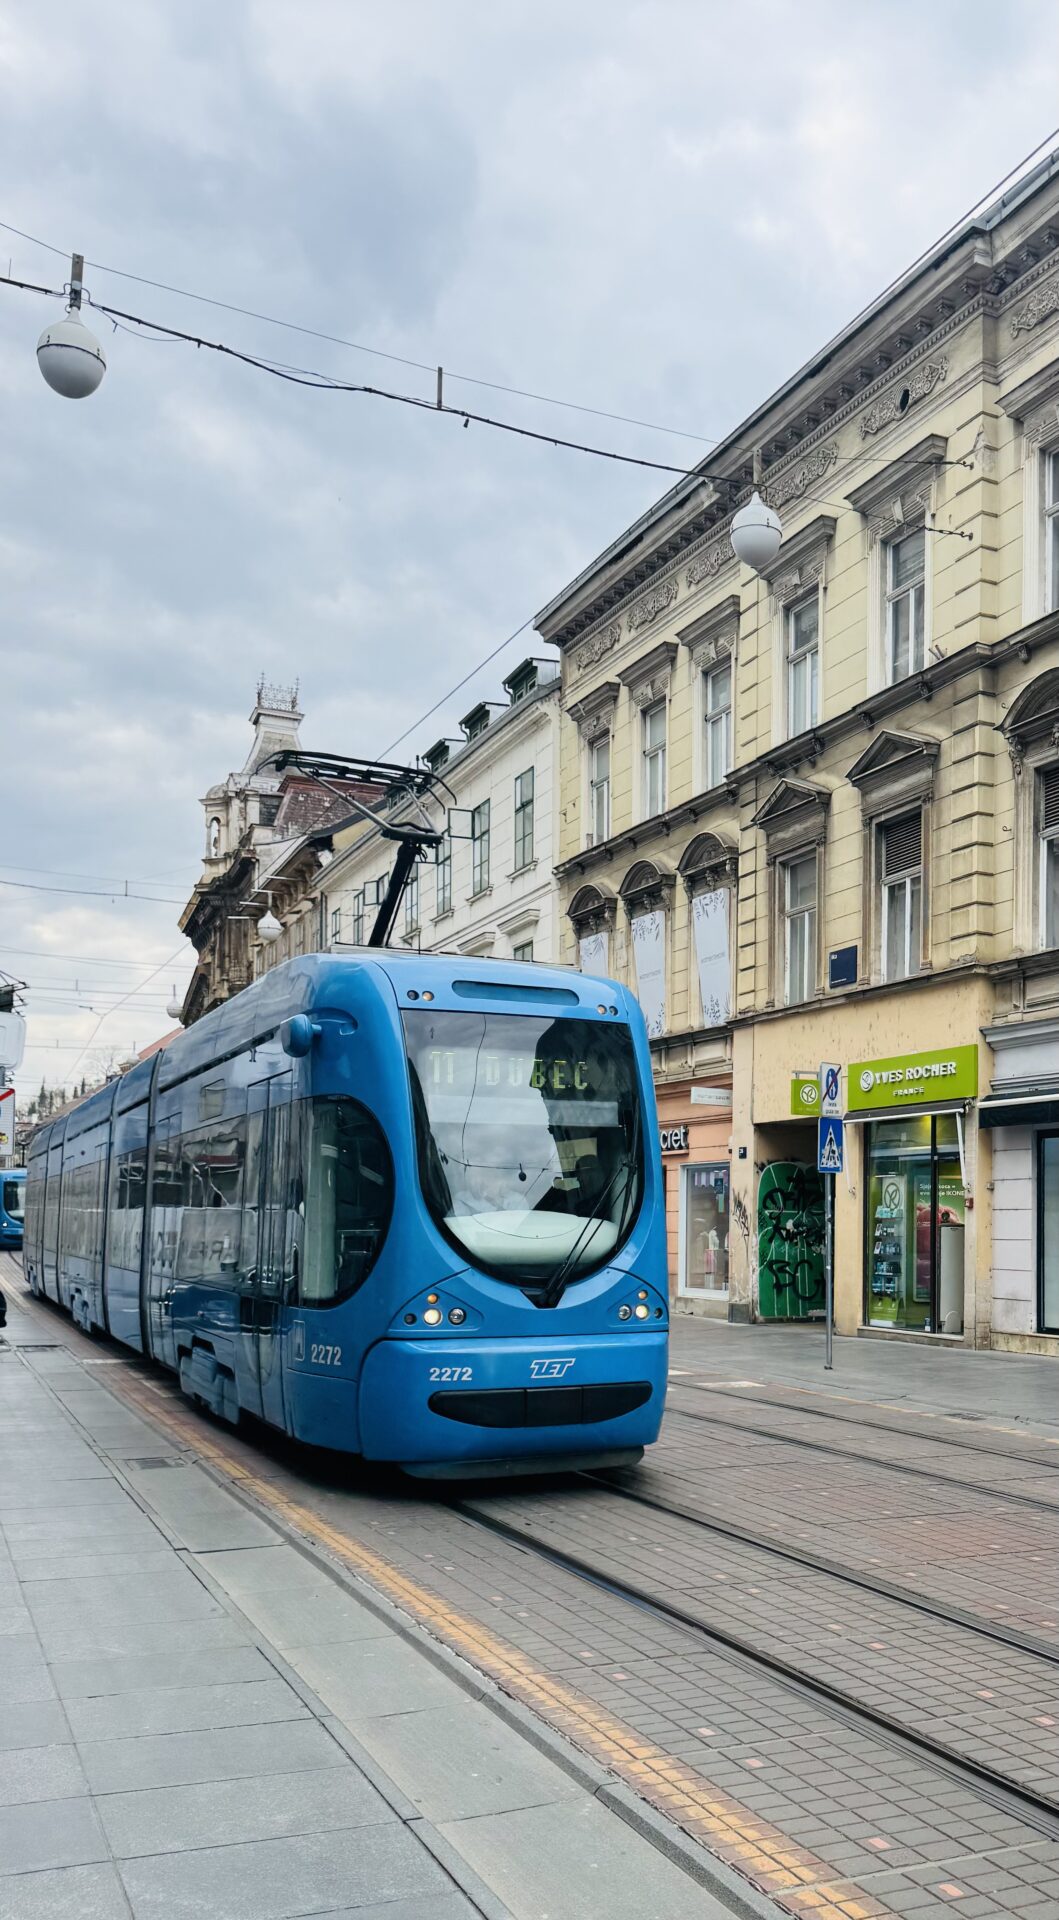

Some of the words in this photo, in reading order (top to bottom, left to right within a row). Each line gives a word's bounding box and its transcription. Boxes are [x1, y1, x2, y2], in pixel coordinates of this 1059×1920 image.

[485, 1056, 588, 1090] DUBEC
[874, 1069, 903, 1084] YVES
[906, 1061, 957, 1080] ROCHER
[892, 1086, 925, 1097] FRANCE
[311, 1343, 342, 1365] 2272
[429, 1367, 473, 1382] 2272
[530, 1357, 576, 1379] ZET
